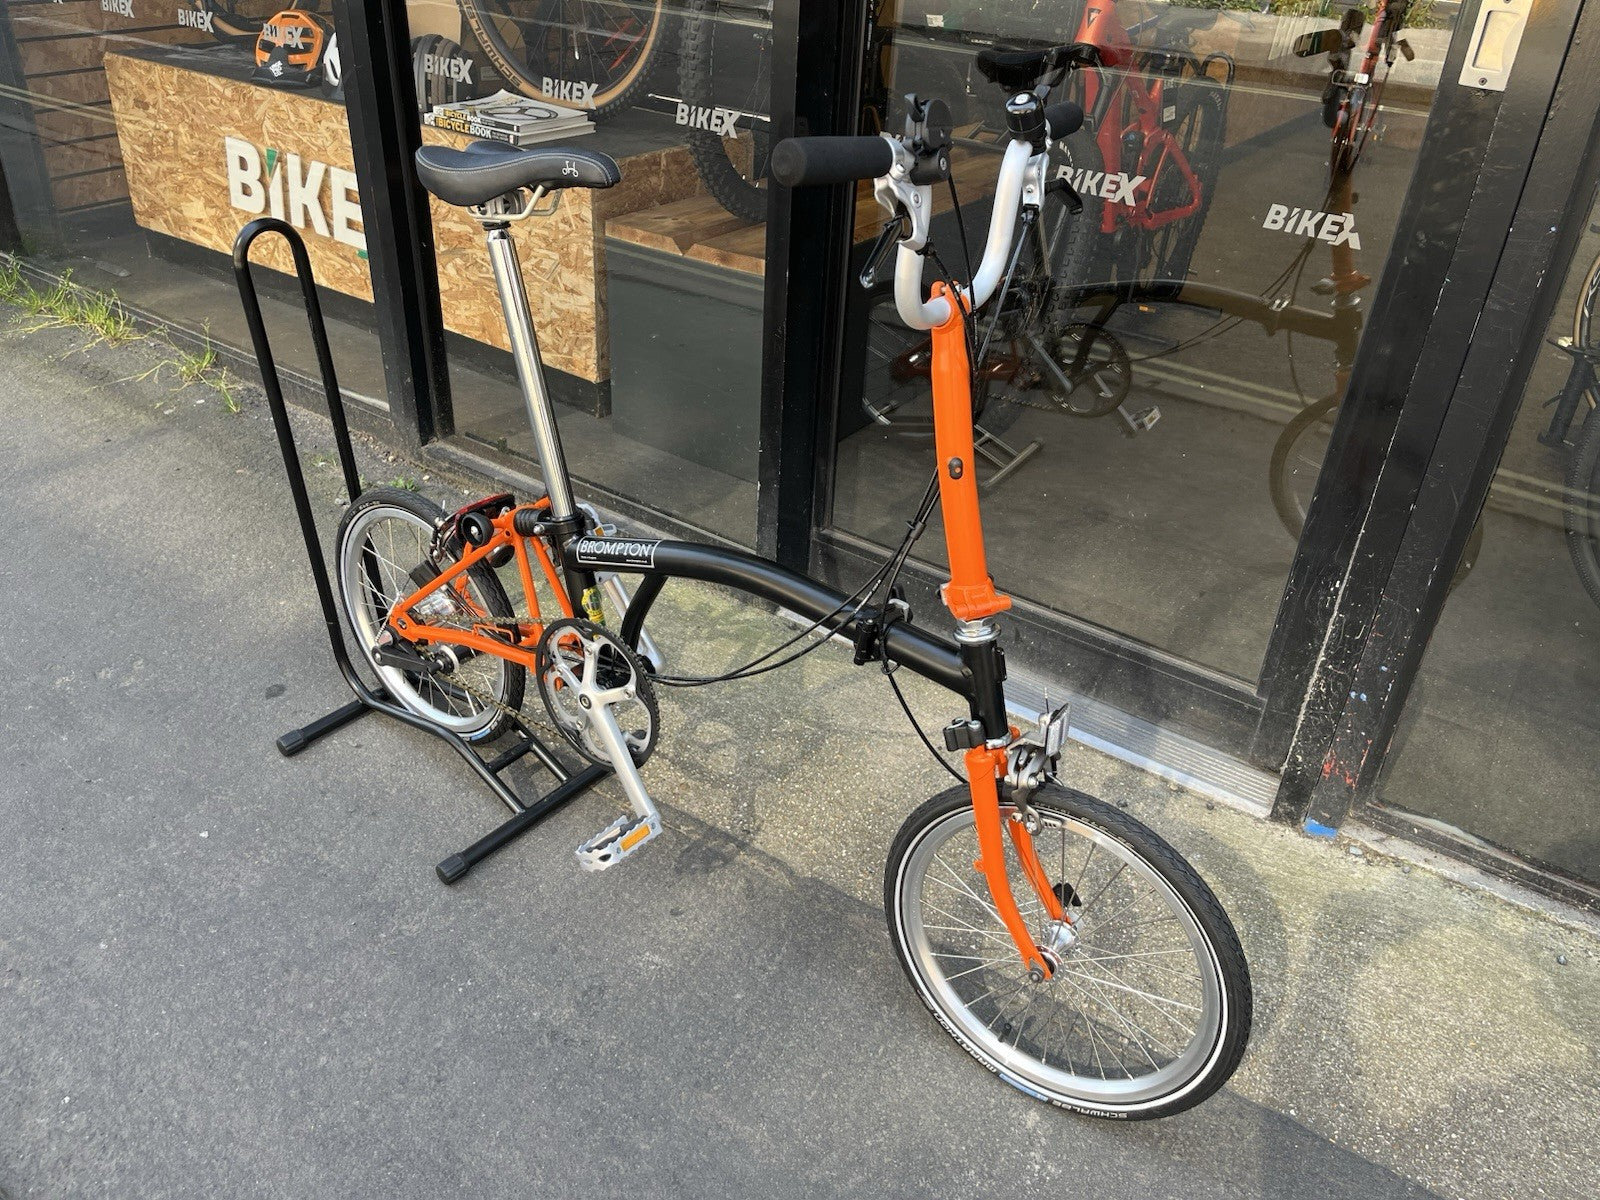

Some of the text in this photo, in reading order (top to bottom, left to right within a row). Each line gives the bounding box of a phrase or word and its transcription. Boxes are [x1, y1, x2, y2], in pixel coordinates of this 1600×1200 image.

[177, 8, 214, 33] BIKEX
[424, 53, 473, 85] BIKEX
[542, 76, 598, 110] BIKEX
[438, 118, 470, 134] BICYCLE
[469, 124, 492, 139] BOOK
[675, 102, 741, 139] BIKEX
[1262, 203, 1361, 250] BIKEX
[580, 540, 652, 557] BROMPTON
[933, 1012, 998, 1074] MARATHON
[1052, 1099, 1128, 1119] SCHWALBE
